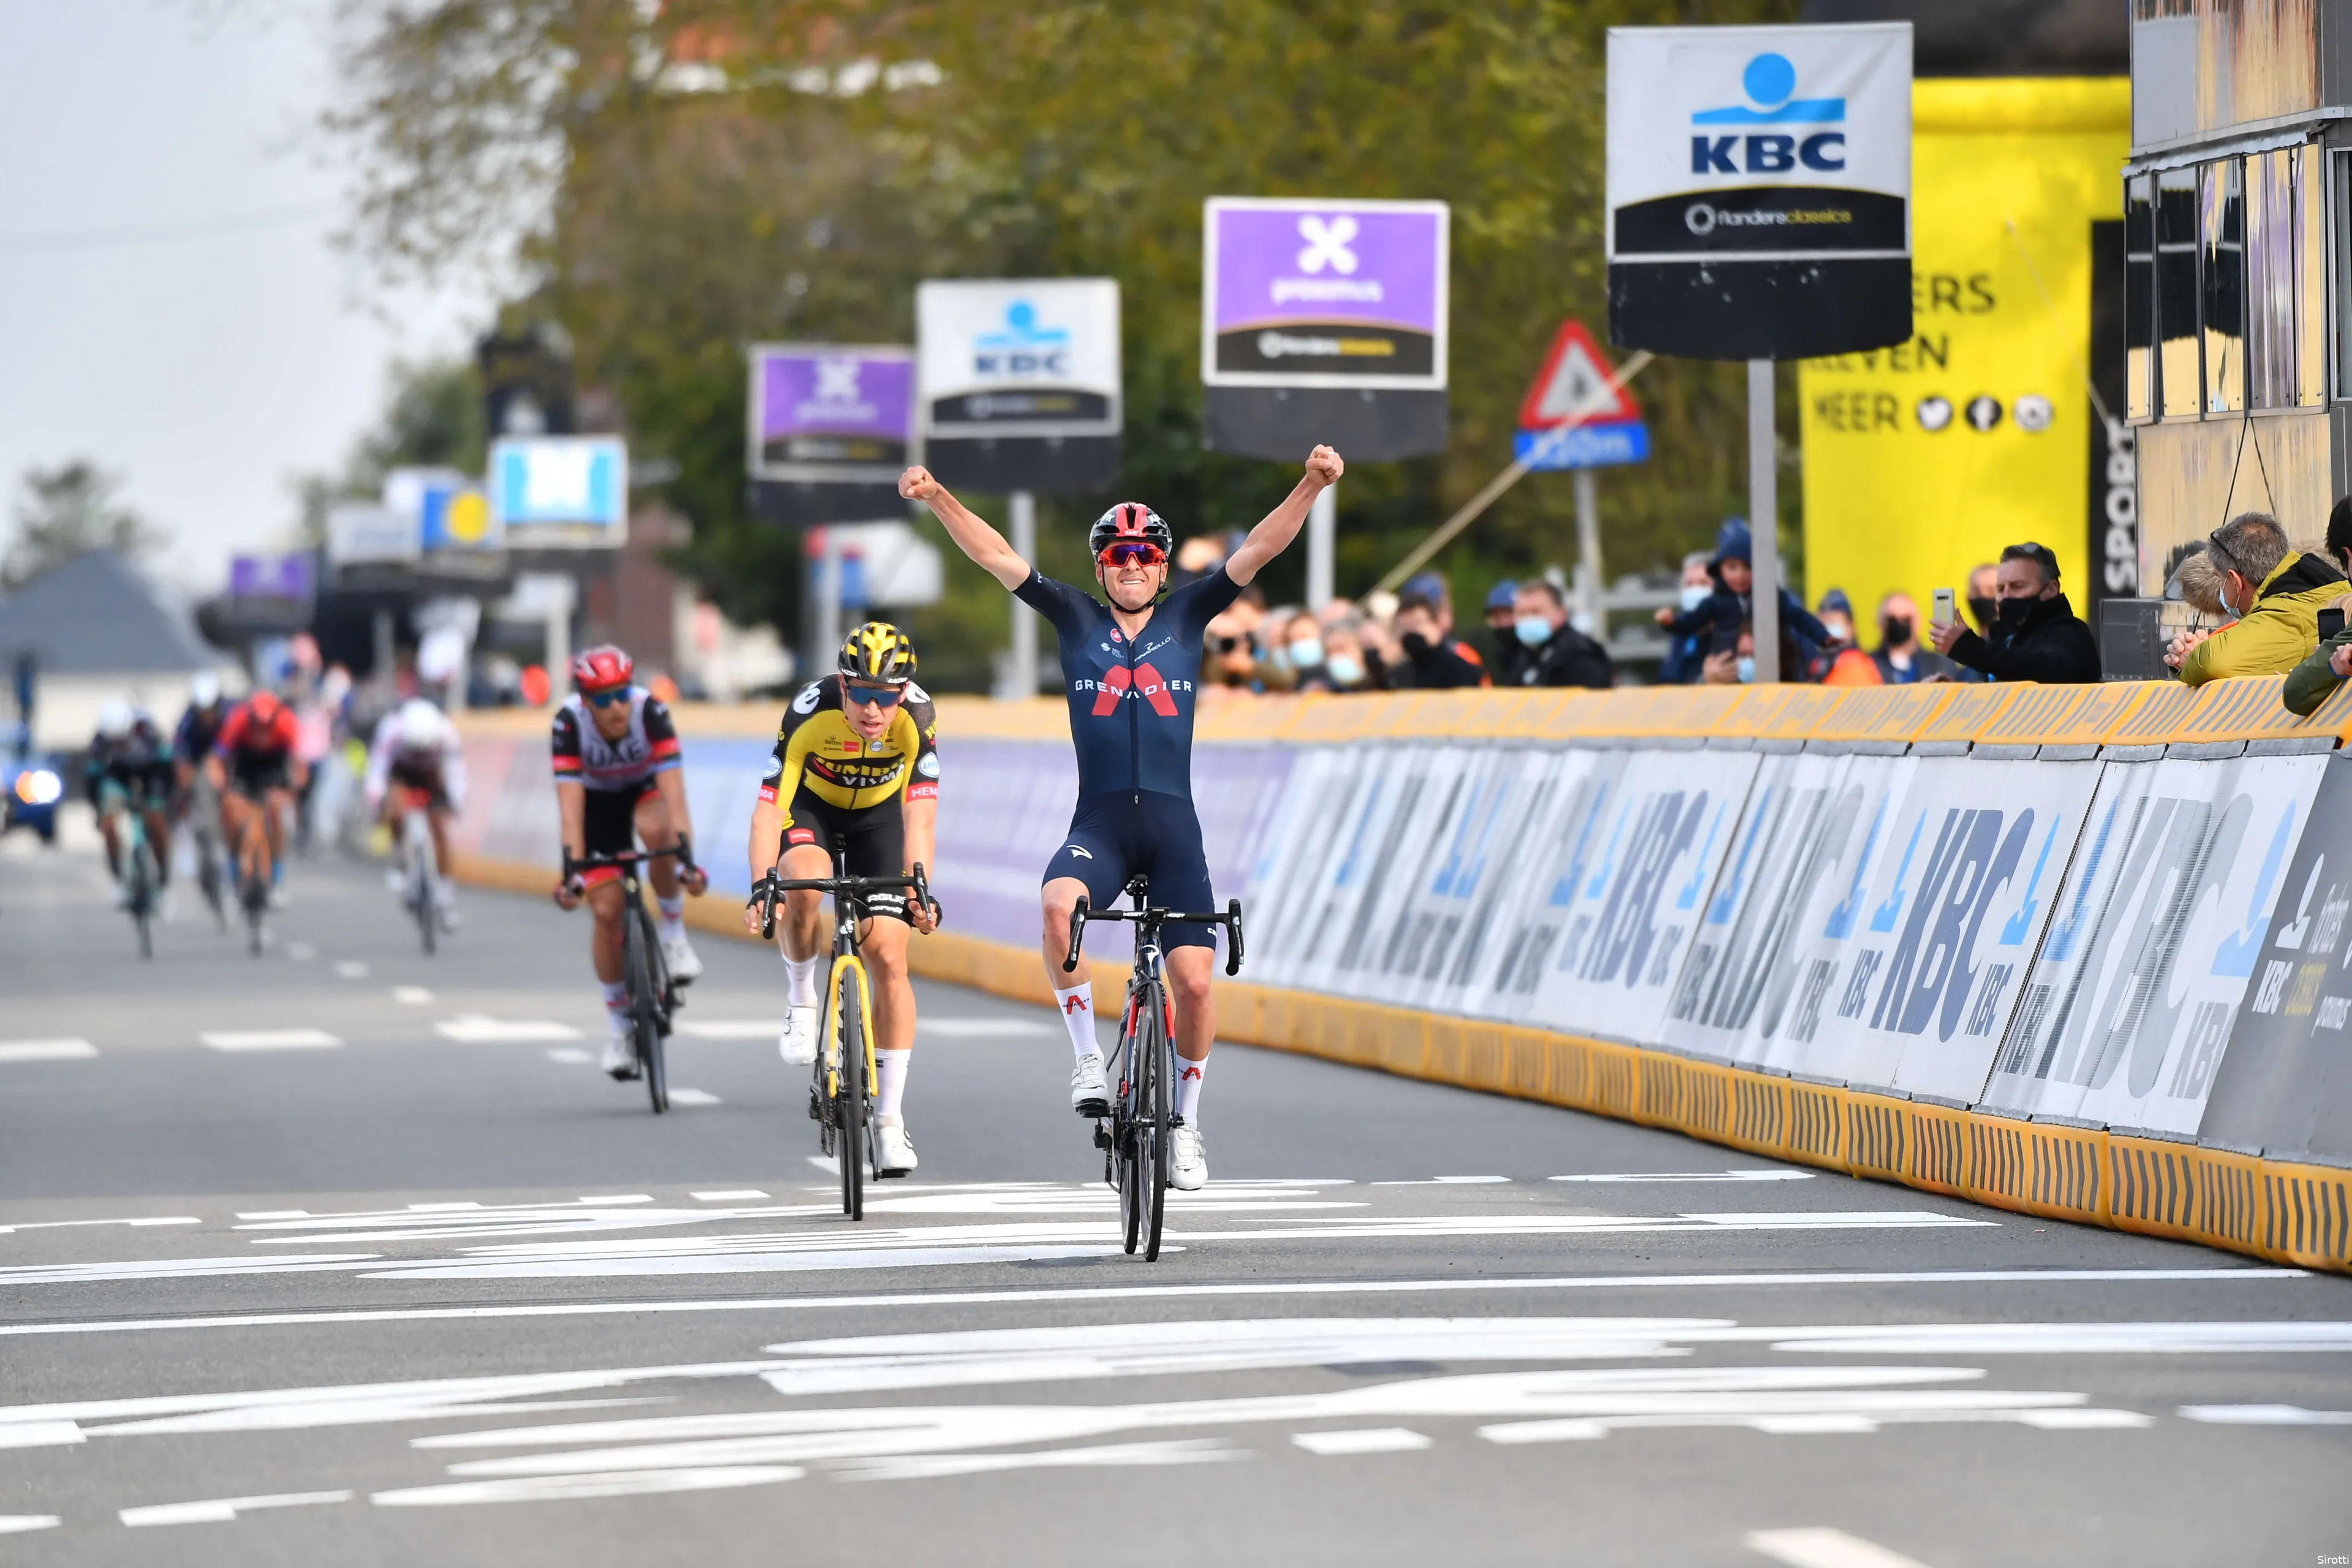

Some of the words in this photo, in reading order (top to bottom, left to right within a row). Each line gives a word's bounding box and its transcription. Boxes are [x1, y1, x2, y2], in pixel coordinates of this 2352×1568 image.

[1691, 133, 1845, 175] KBC
[1075, 679, 1193, 699] GRENADIER
[1869, 807, 2035, 1042] KBC
[1838, 949, 1883, 1019] KBC
[1964, 963, 2014, 1037] KBC
[2252, 959, 2293, 1014] KBC
